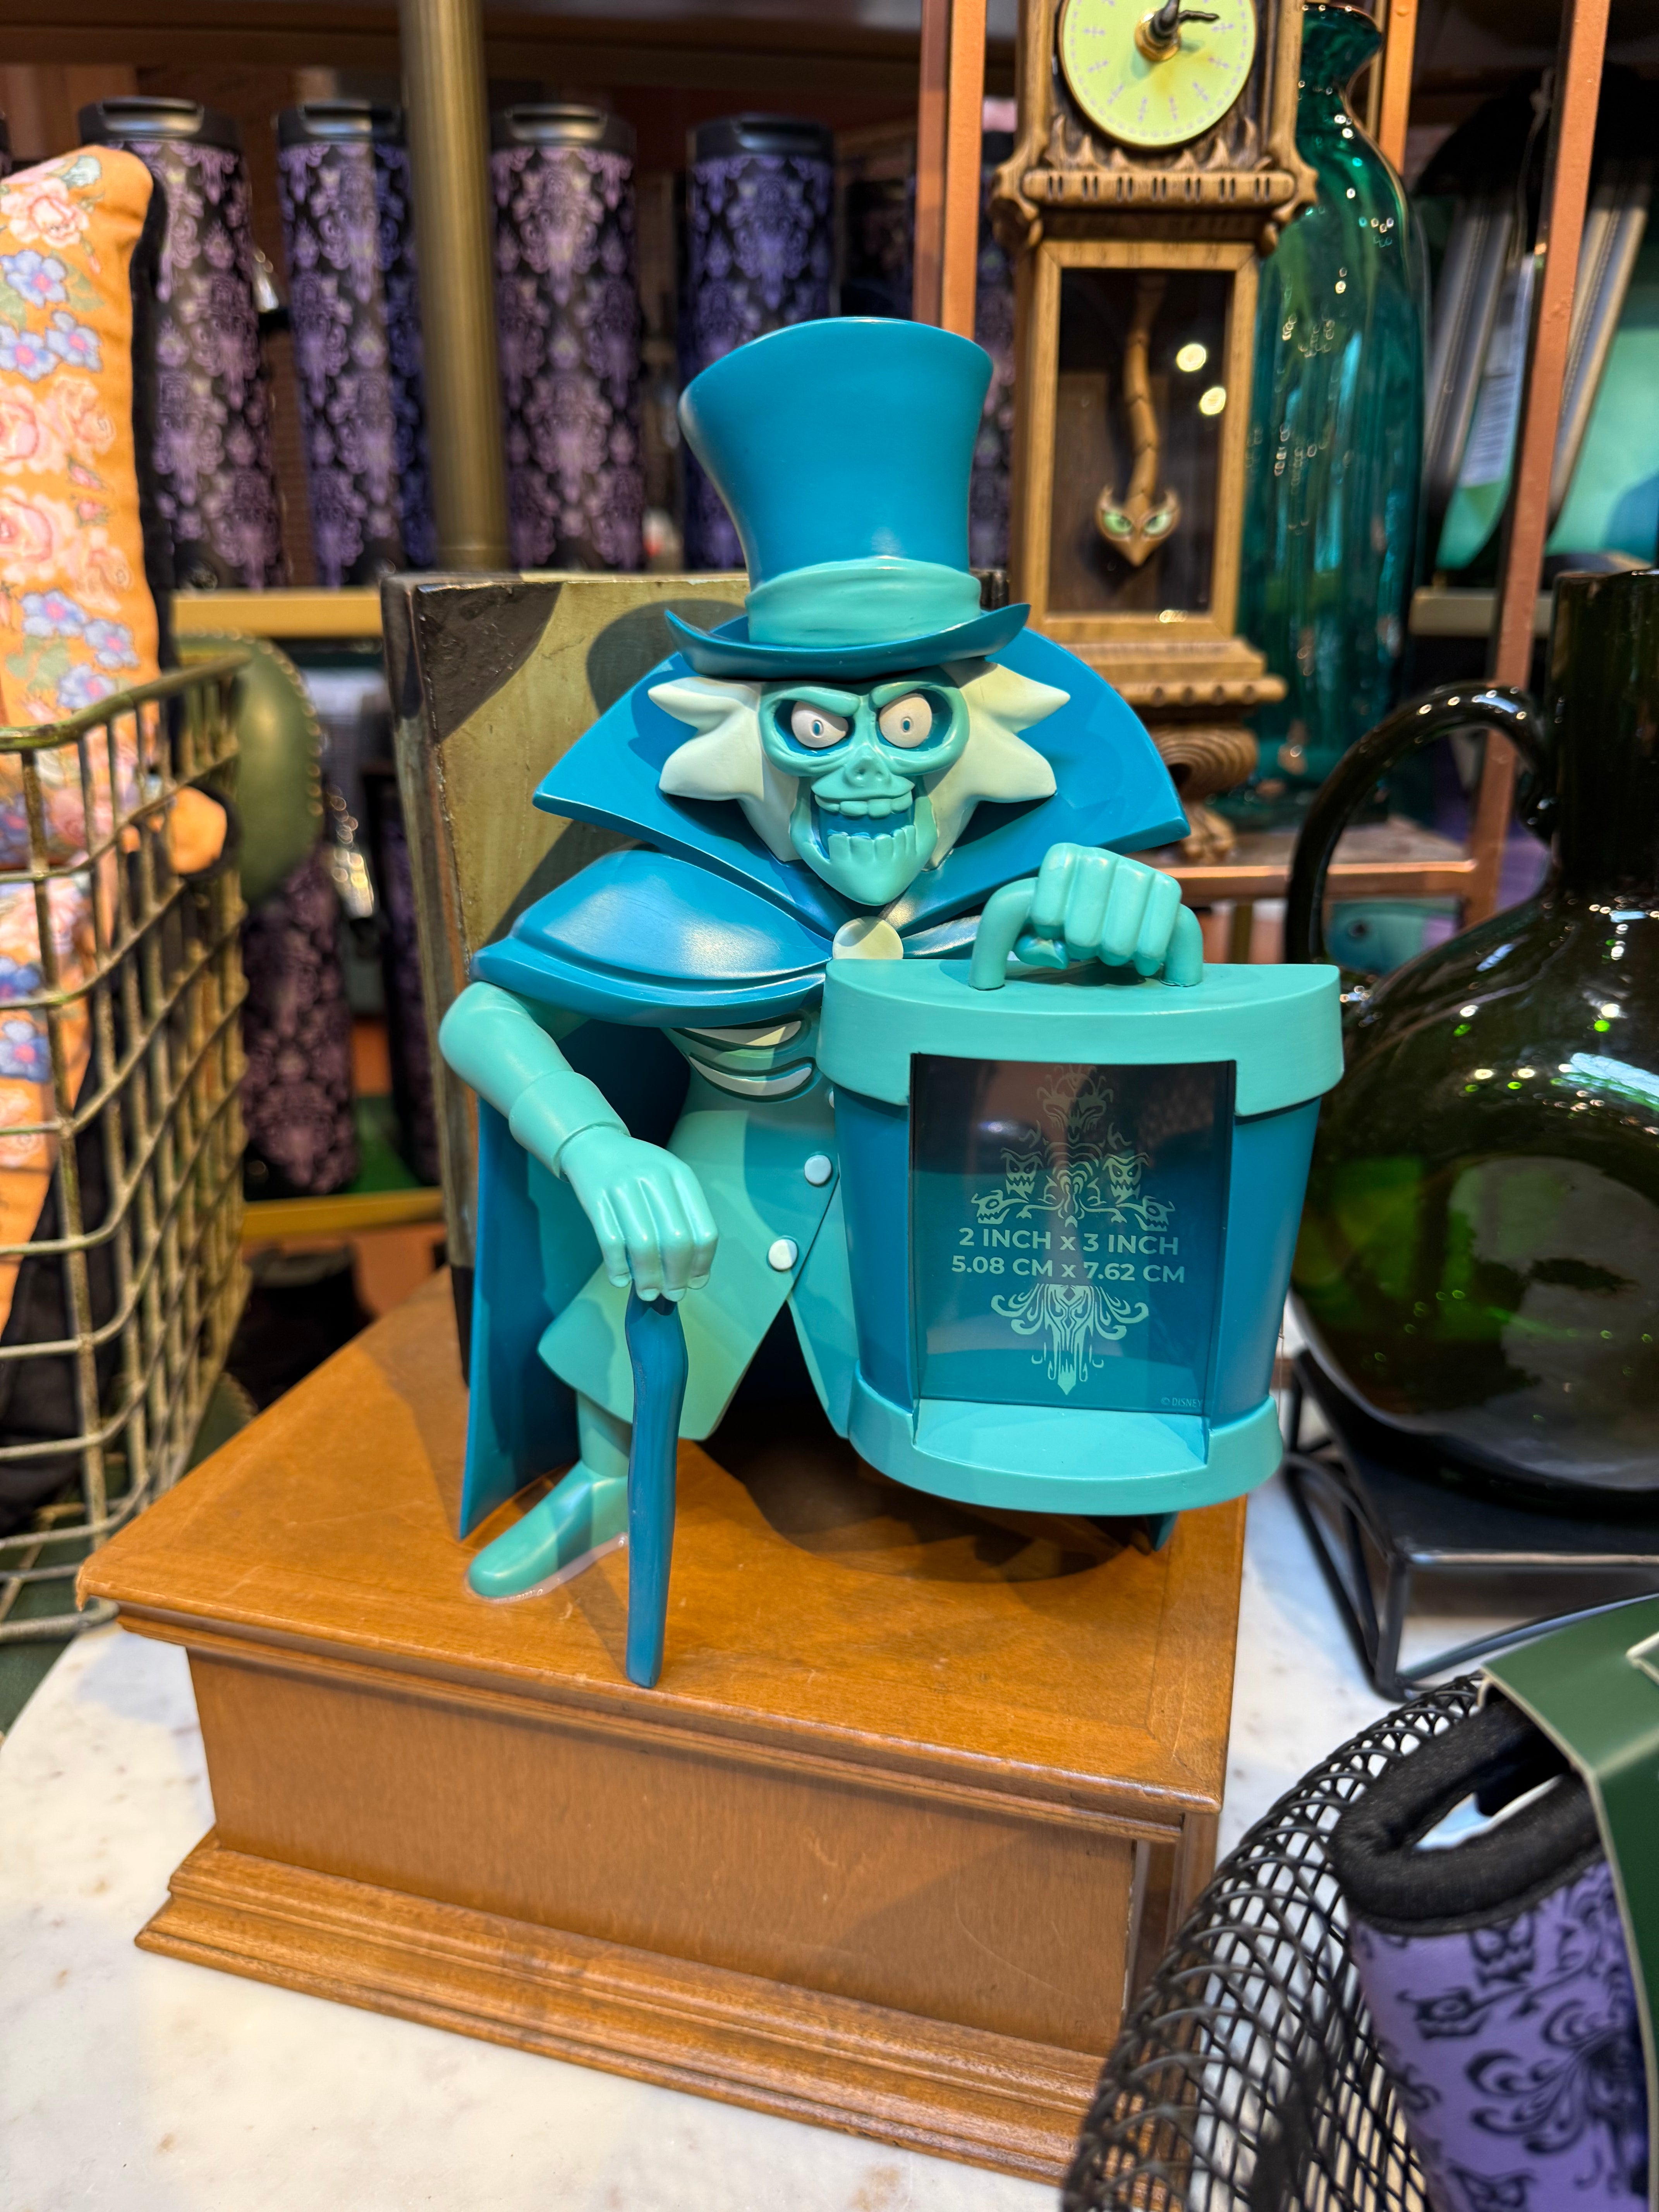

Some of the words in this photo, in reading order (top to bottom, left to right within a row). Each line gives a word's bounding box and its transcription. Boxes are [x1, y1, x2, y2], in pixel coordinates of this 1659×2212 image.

[959, 1227, 975, 1247] 2
[983, 1228, 1051, 1250] INCH
[1083, 1233, 1099, 1252] 3
[1108, 1234, 1179, 1255] INCH
[951, 1255, 1005, 1275] 5.08
[1012, 1258, 1053, 1278] CM
[1083, 1261, 1135, 1281] 7.62
[1143, 1264, 1185, 1283] CM
[1172, 1397, 1203, 1407] DISNEY
